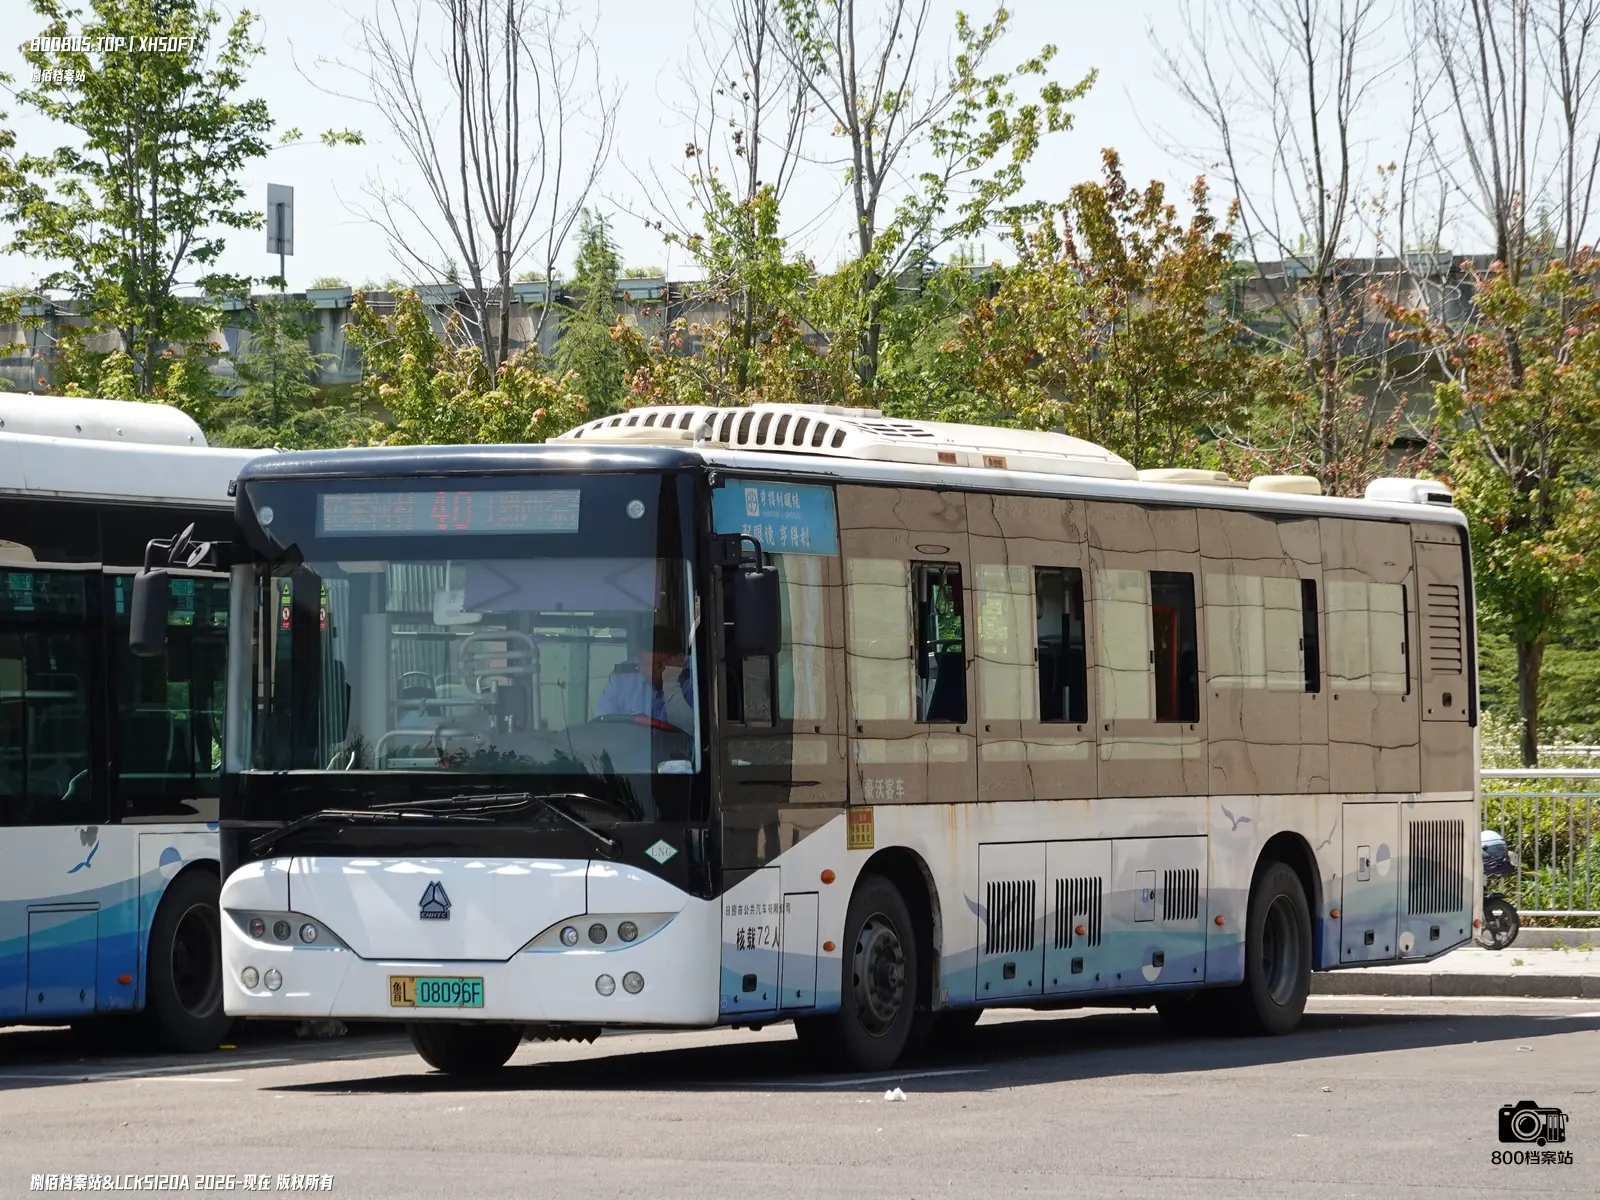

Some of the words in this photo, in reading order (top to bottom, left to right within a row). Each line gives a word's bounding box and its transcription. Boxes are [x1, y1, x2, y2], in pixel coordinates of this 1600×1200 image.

[429, 491, 472, 530] 40
[779, 524, 810, 548] 亨得利
[864, 778, 905, 800] 豪沃客车
[651, 847, 672, 857] LNG
[736, 925, 780, 952] 核载72人
[420, 981, 481, 1003] 08096F
